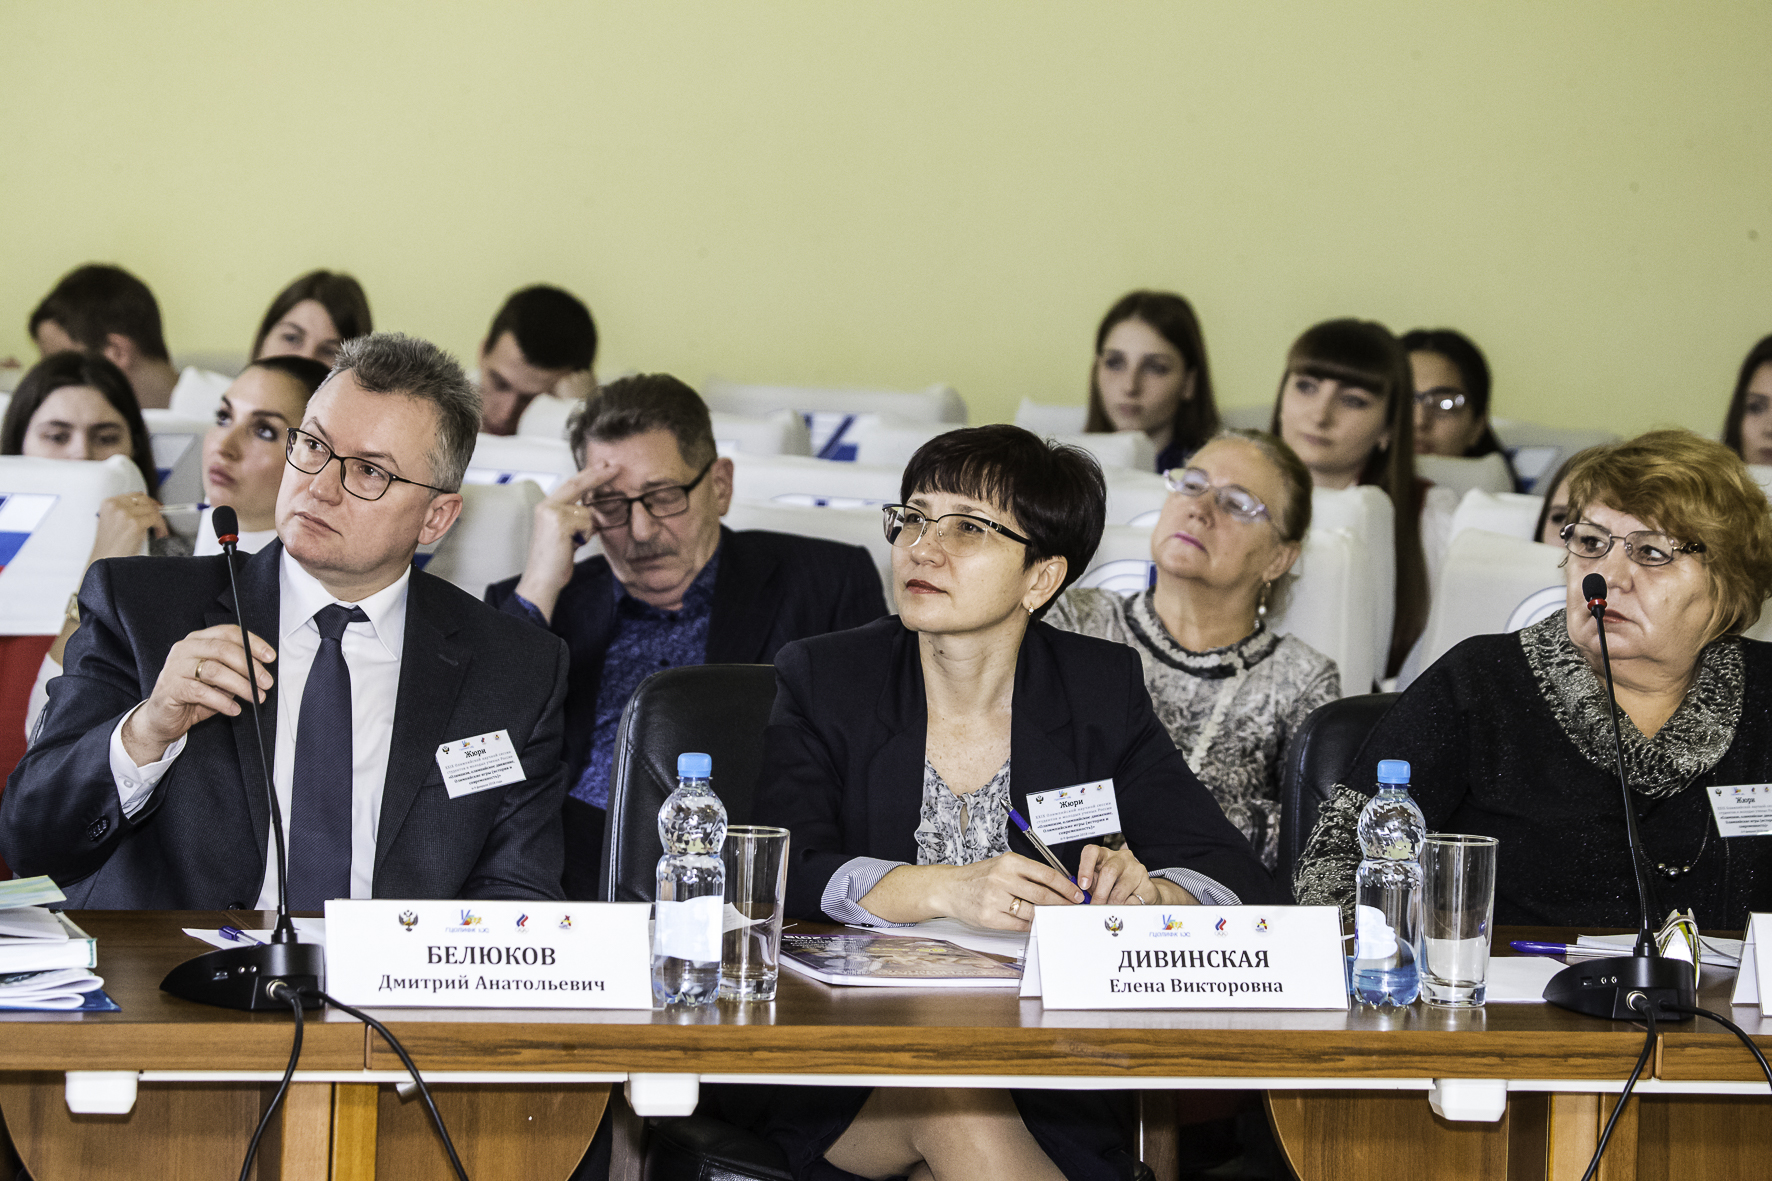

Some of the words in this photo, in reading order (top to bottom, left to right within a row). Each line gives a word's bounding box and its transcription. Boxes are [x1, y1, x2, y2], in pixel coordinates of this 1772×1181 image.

[465, 749, 486, 758] Жюри
[1060, 800, 1083, 809] Жюри
[427, 946, 556, 965] БЕЛЮКОВ
[1118, 950, 1270, 972] ДИВИНСКАЯ
[378, 974, 469, 992] Дмитрий
[475, 975, 605, 991] Анатольевич
[1110, 978, 1166, 993] Елена
[1170, 978, 1284, 996] Викторовна
